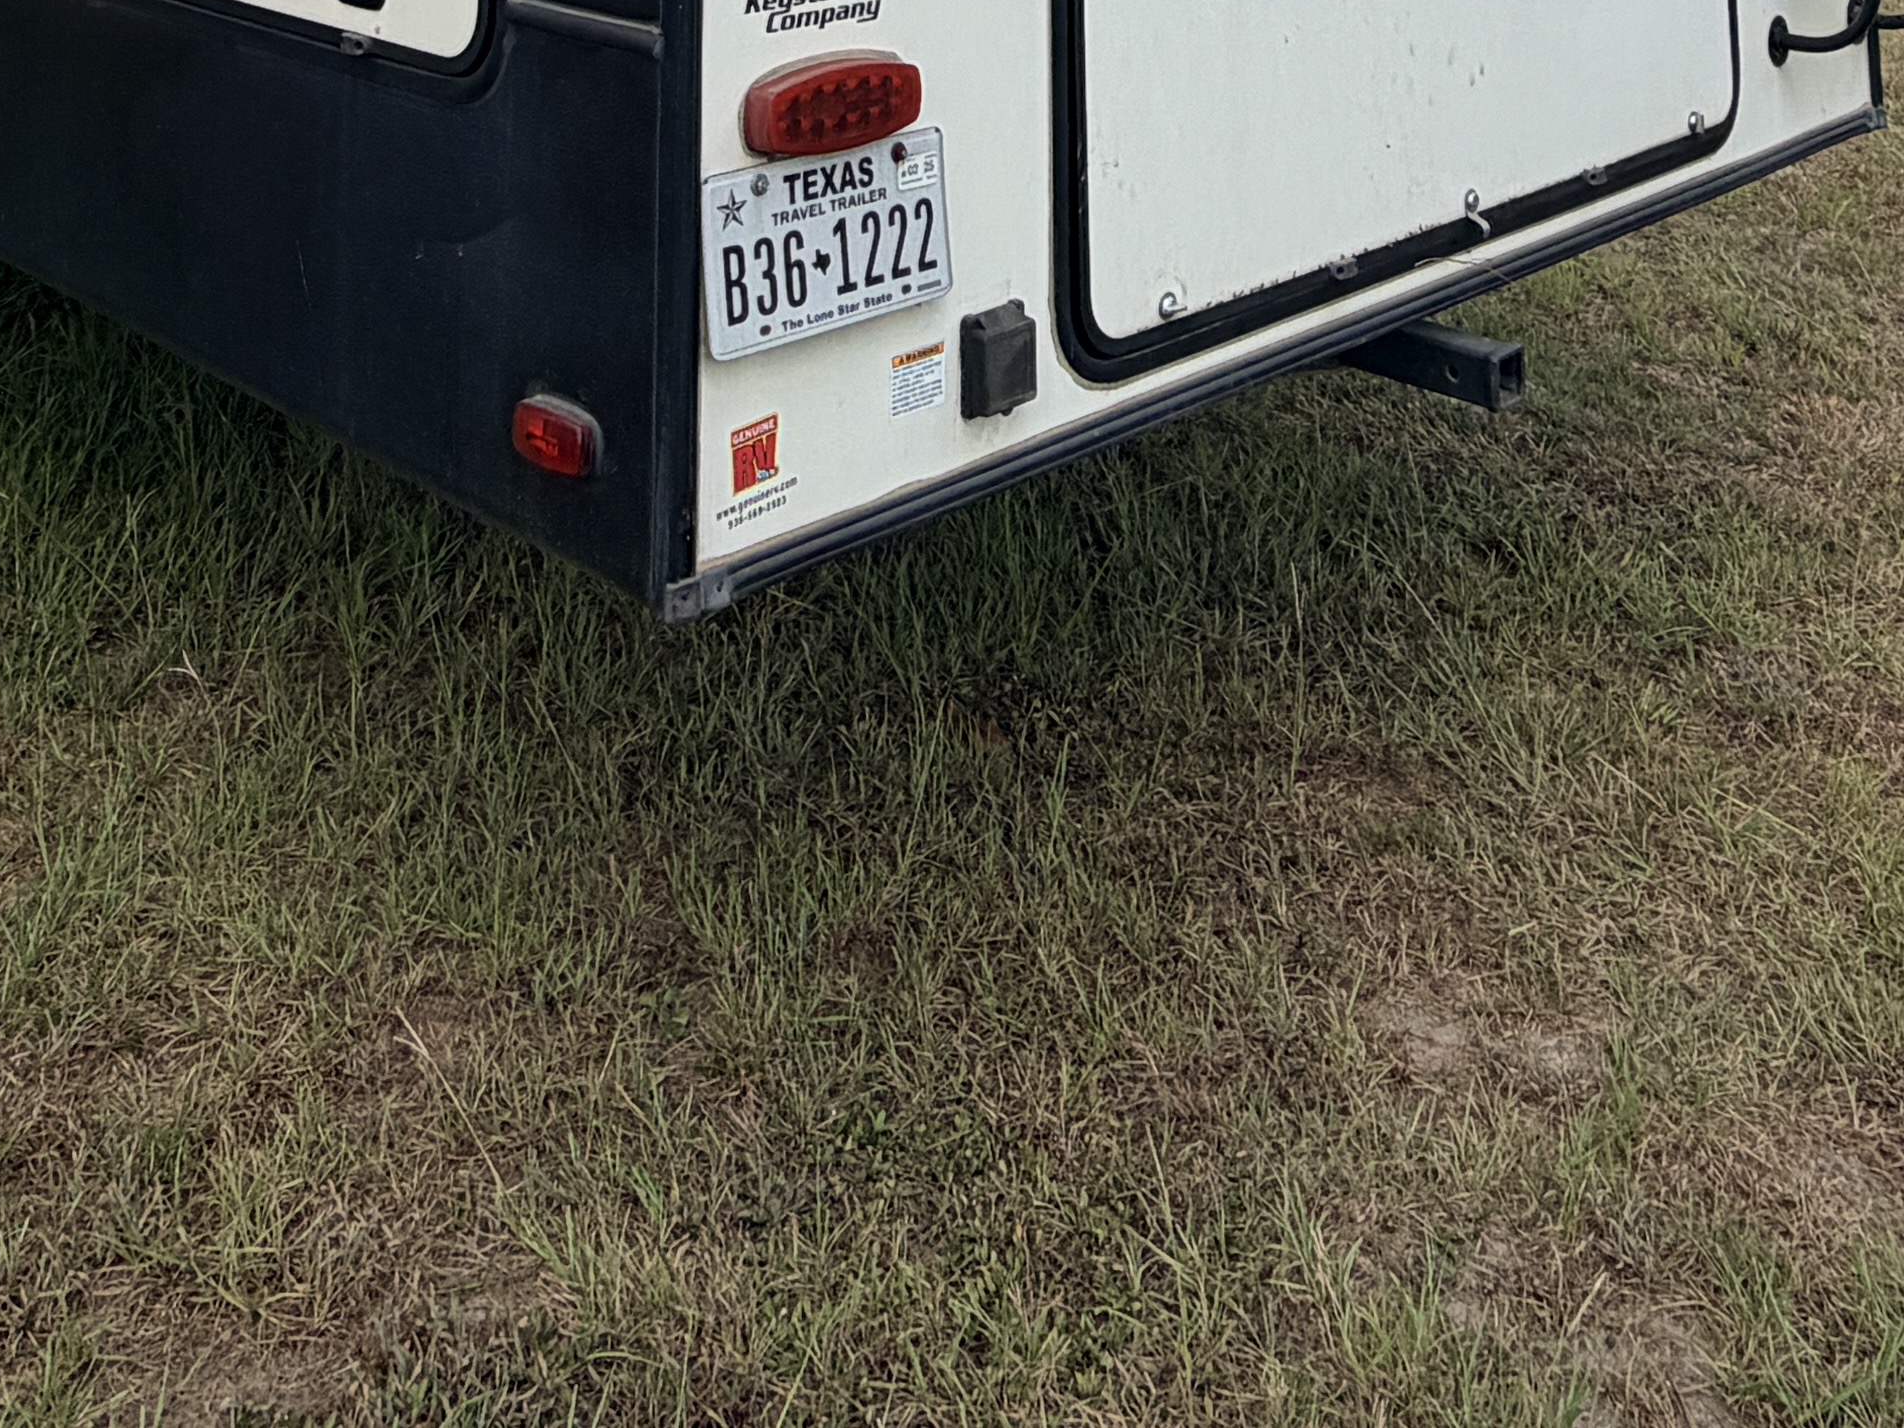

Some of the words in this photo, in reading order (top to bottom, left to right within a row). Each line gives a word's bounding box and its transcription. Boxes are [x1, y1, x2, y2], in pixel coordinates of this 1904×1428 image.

[783, 156, 874, 206] TEXAS
[771, 201, 826, 227] TRAVEL
[830, 187, 888, 212] TRAILER
[722, 230, 808, 327] B36
[832, 197, 938, 296] 1222
[781, 319, 804, 333] The
[806, 309, 834, 325] Lone
[837, 300, 861, 316] Star
[863, 293, 893, 309] State
[732, 418, 776, 445] GENUINE
[733, 433, 777, 493] RV
